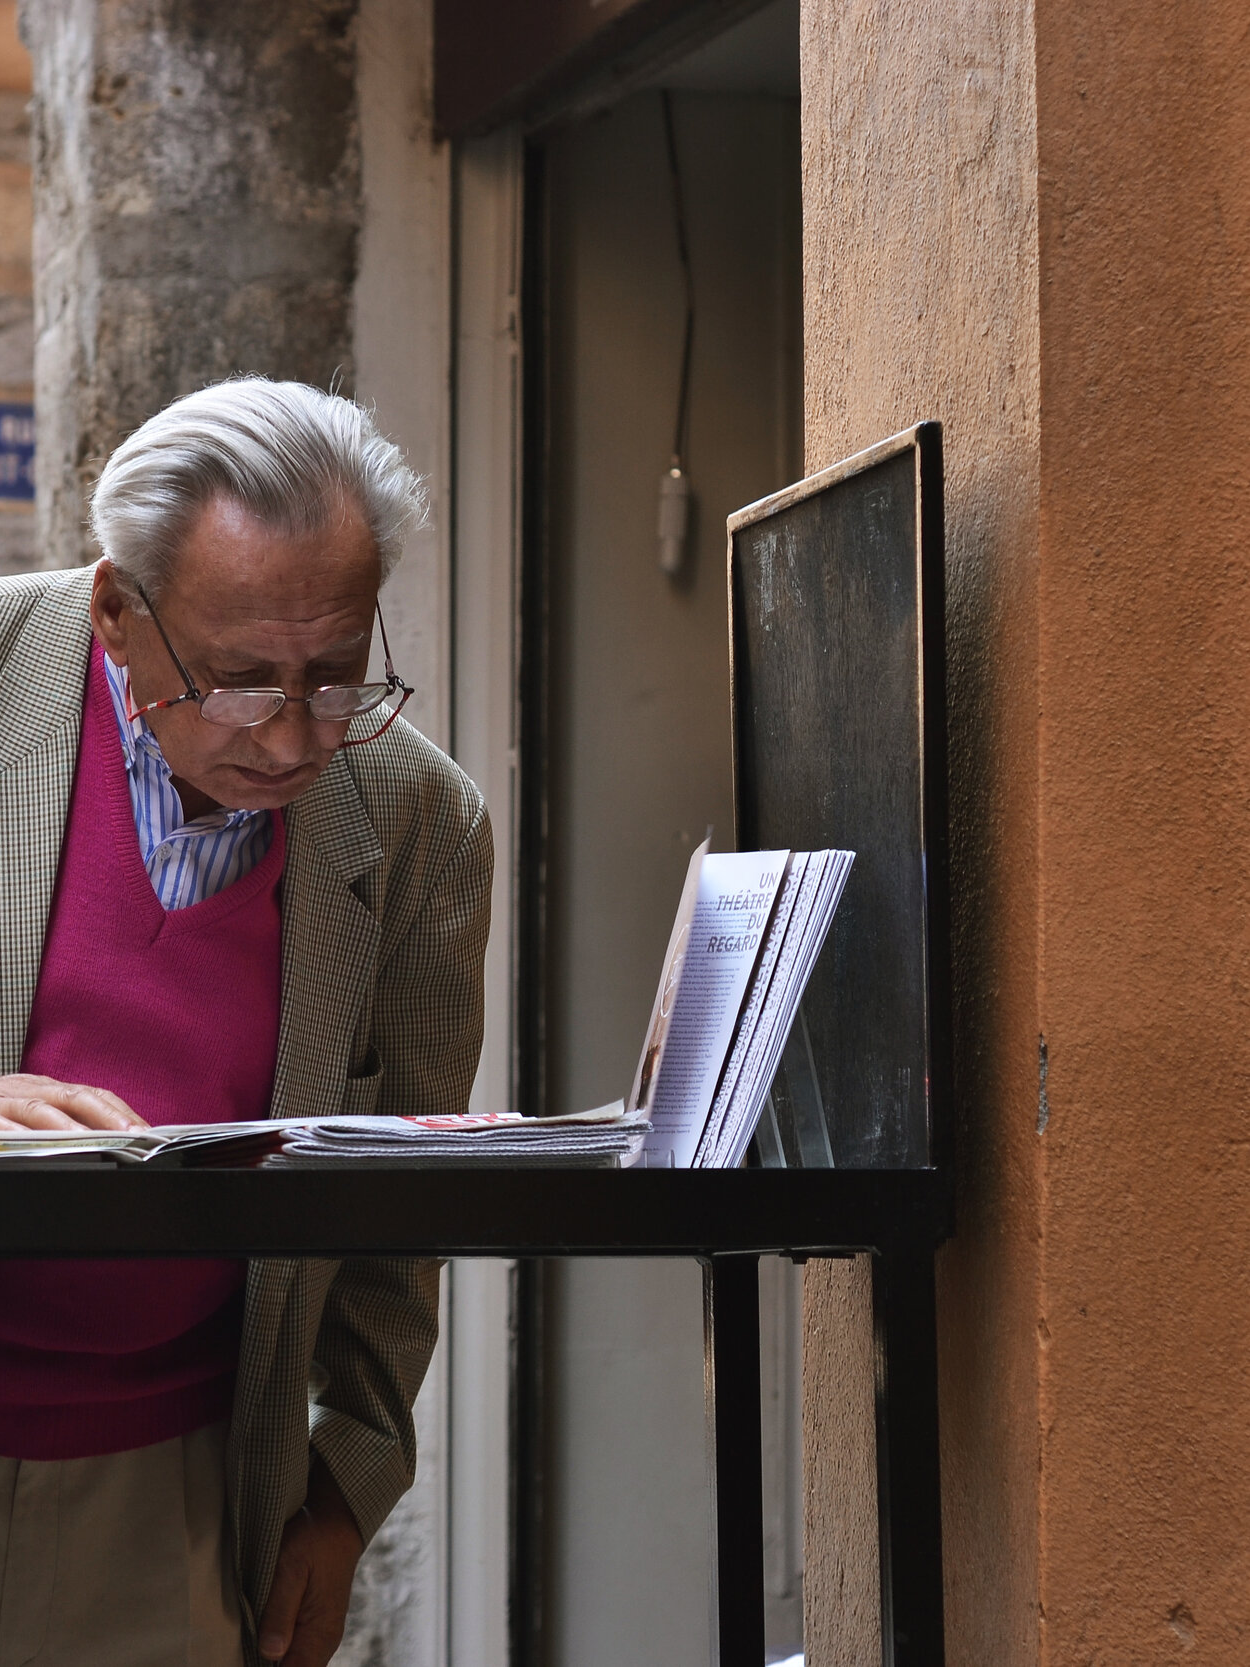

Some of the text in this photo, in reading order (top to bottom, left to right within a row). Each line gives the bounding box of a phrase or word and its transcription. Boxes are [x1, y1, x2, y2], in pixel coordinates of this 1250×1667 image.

[759, 872, 778, 889] UN
[716, 889, 772, 911] THÉÂTRE
[747, 913, 765, 930] DU
[706, 934, 758, 953] REGARD
